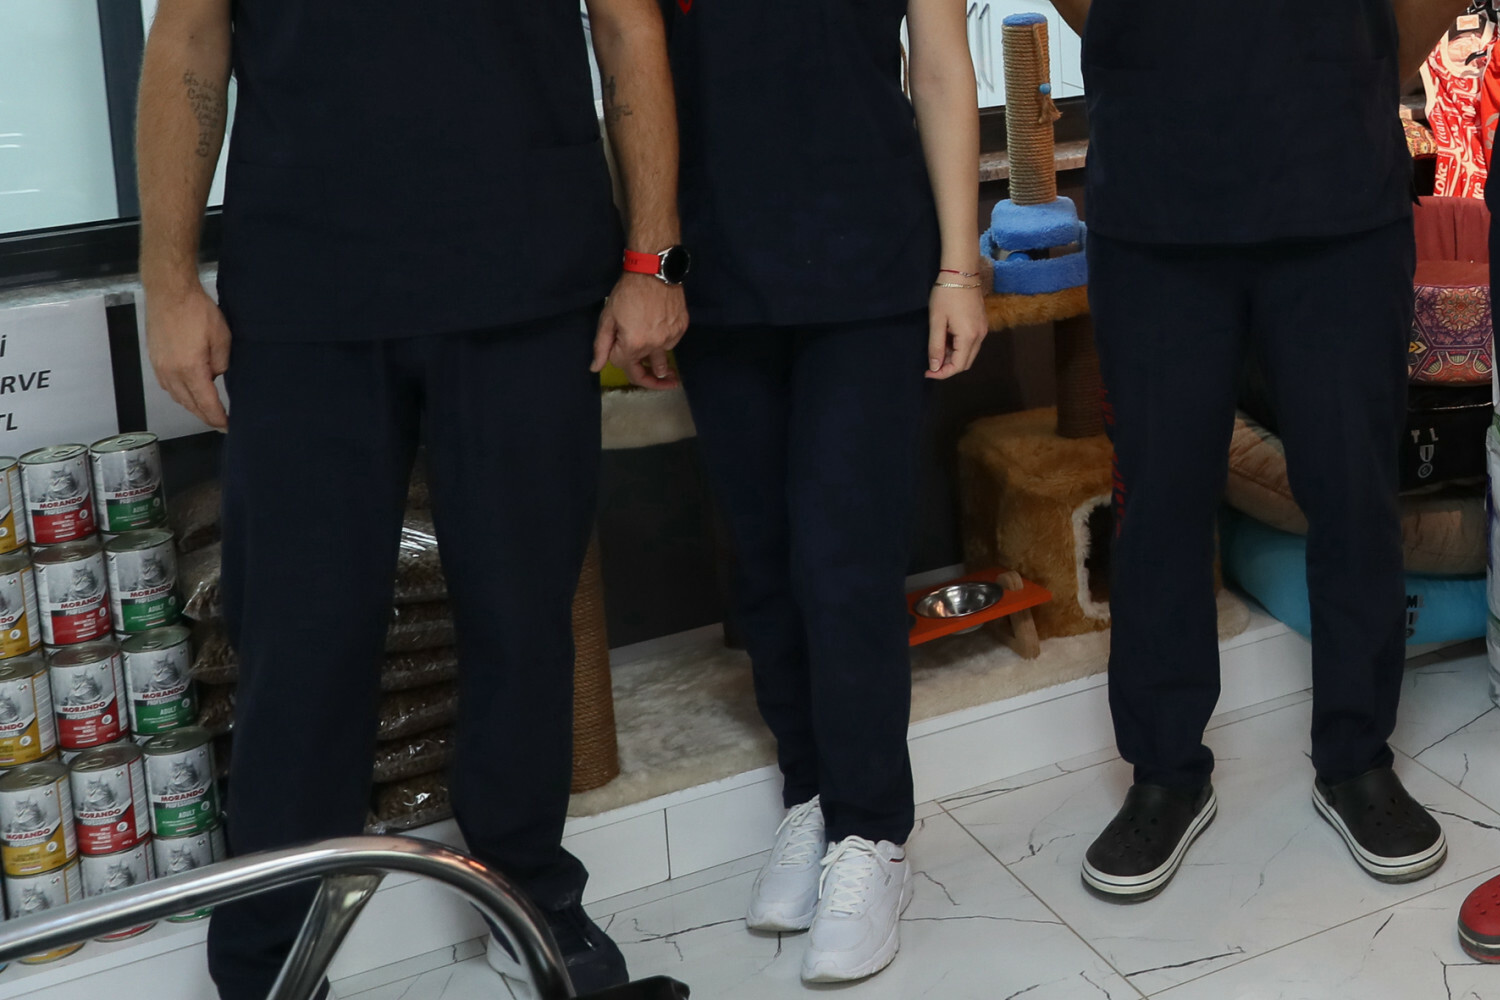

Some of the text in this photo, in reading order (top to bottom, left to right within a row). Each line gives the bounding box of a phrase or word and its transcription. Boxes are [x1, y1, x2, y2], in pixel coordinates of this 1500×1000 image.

[0, 370, 51, 395] RVE
[115, 485, 156, 498] MORANDO
[39, 497, 83, 509] MORANDO
[130, 584, 172, 598] MORANDO
[61, 595, 101, 609] MORANDO
[142, 685, 185, 699] MORANDO
[62, 701, 106, 713] MORANDO
[160, 706, 177, 715] ADULT
[0, 722, 24, 731] ANDO
[160, 788, 204, 802] MORANDO
[79, 808, 121, 819] MORANDO
[178, 809, 196, 819] ADULT
[6, 828, 51, 840] MORANDO
